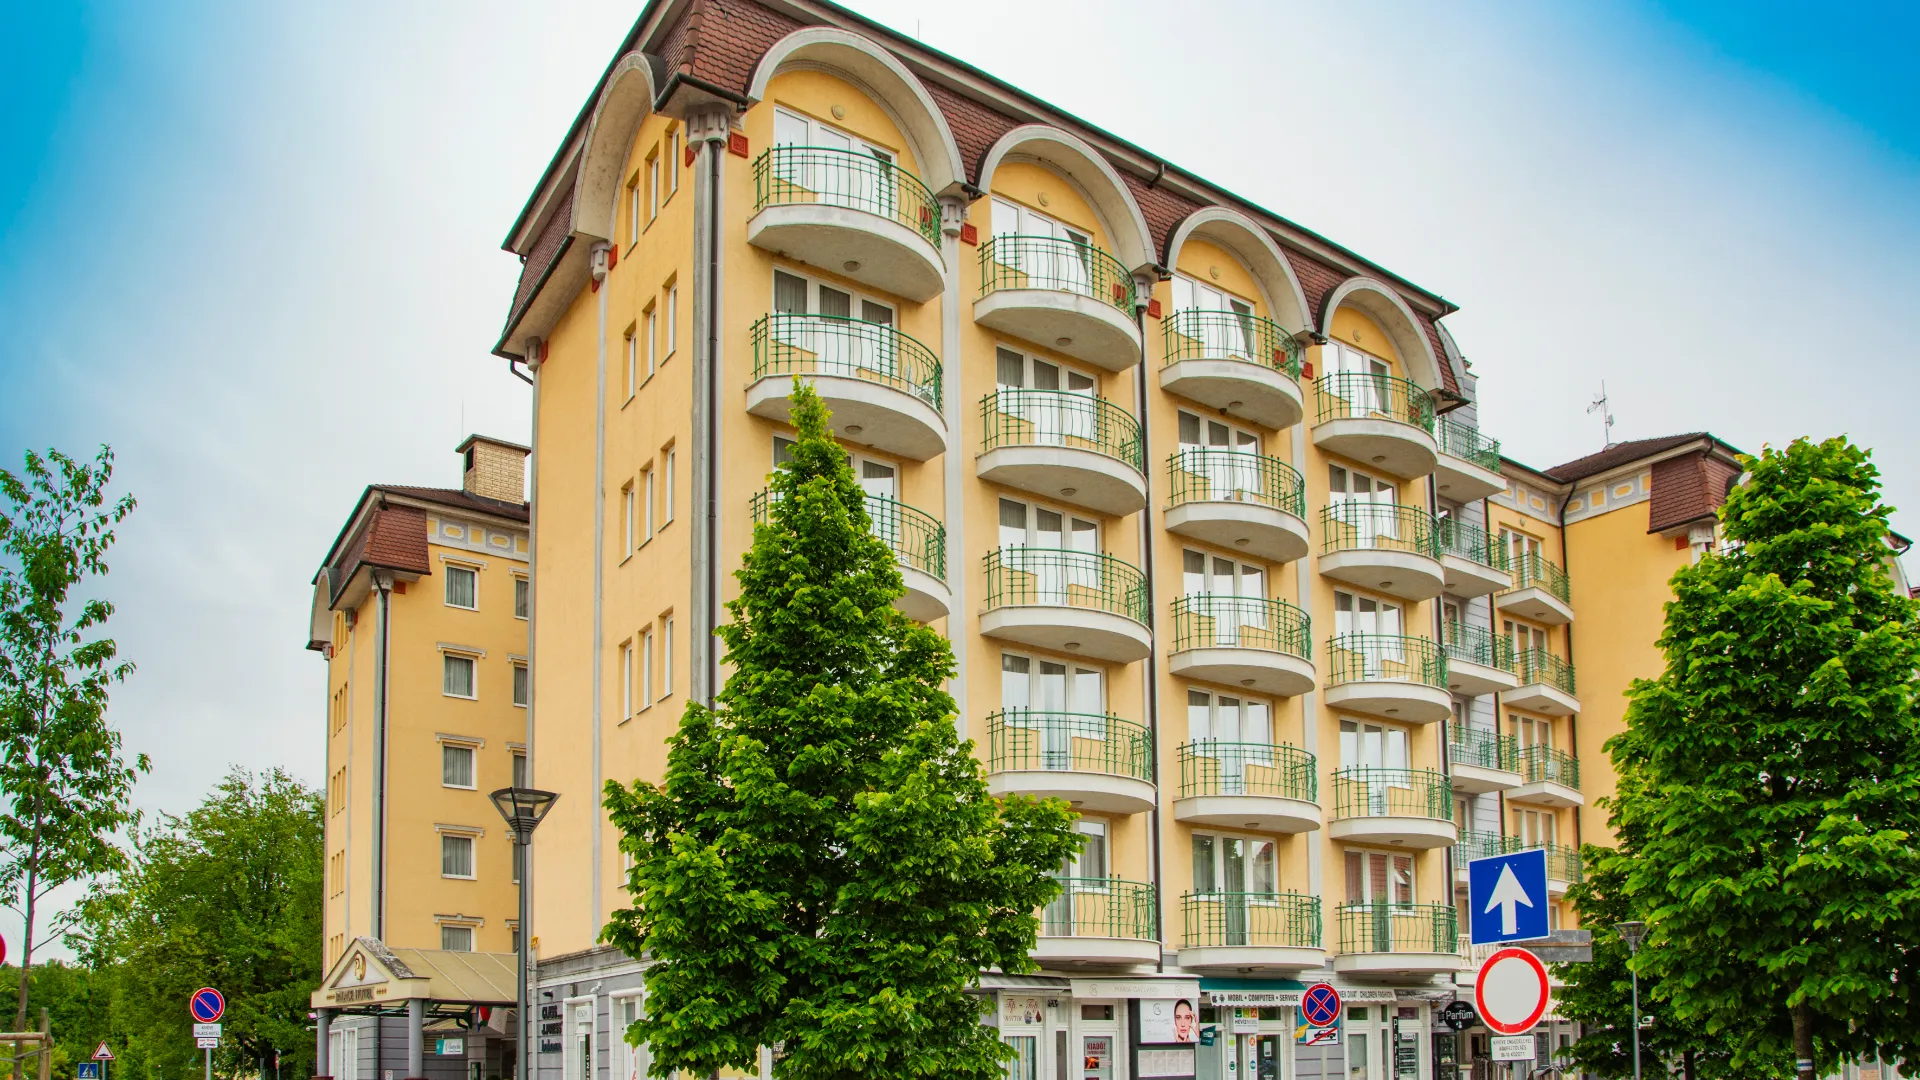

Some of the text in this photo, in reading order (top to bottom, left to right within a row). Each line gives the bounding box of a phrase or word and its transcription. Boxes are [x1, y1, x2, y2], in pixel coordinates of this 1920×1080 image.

[1228, 994, 1299, 1002] MOBIL COMPUTER SERVICE
[1445, 1010, 1474, 1020] Parfüm
[1086, 1041, 1106, 1050] KIADÓ!
